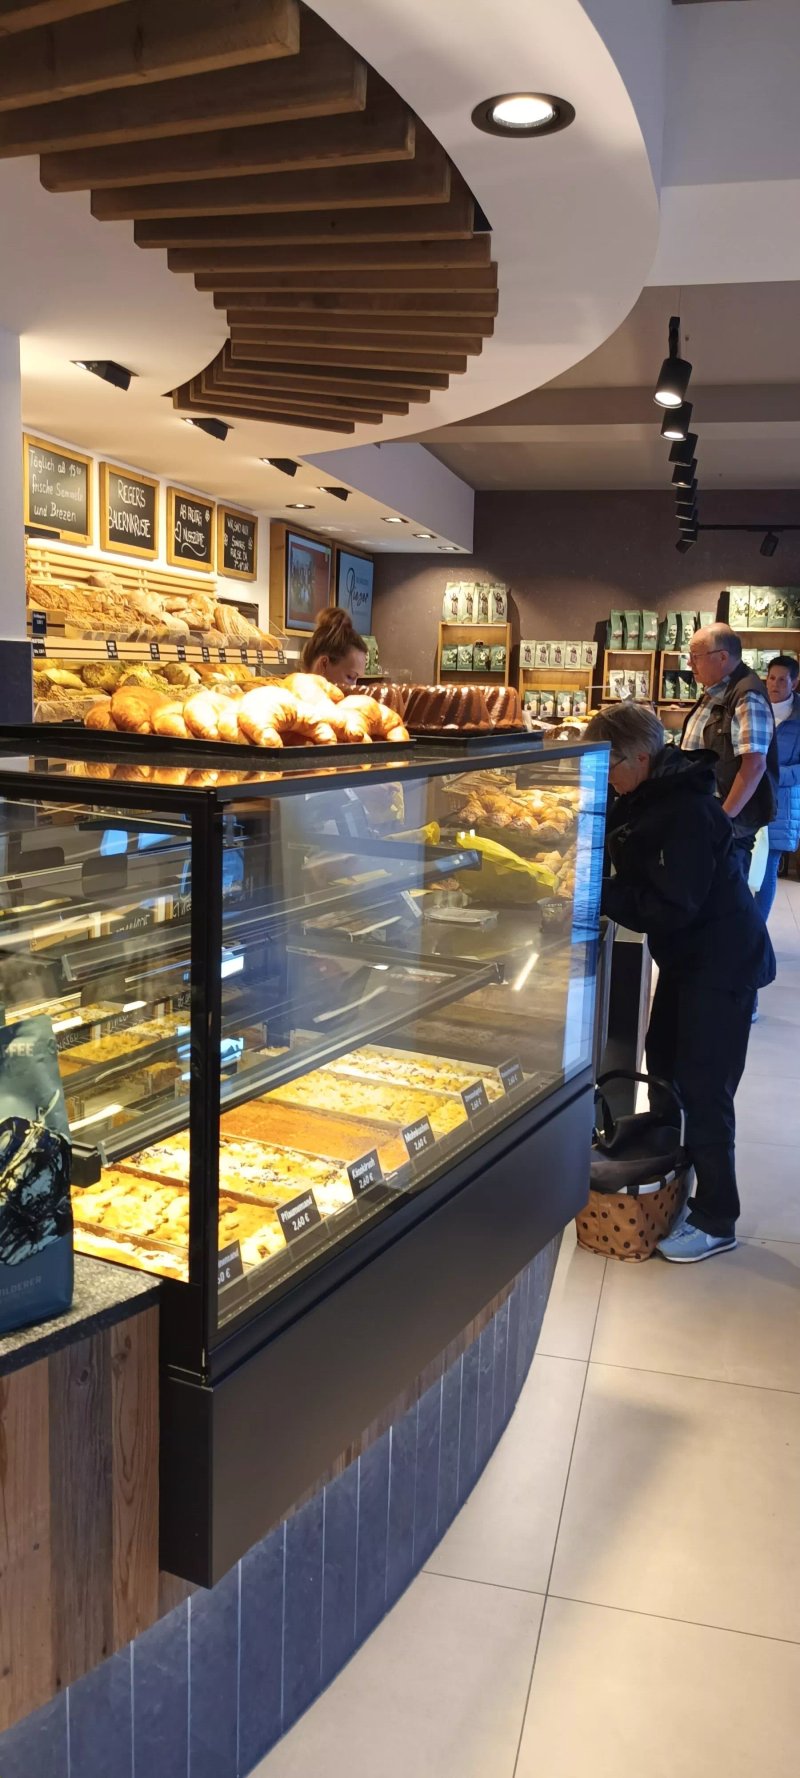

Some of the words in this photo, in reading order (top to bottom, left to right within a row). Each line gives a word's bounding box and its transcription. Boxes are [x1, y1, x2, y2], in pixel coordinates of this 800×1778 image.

[30, 449, 55, 474] Täglich
[32, 474, 54, 495] frische
[33, 504, 48, 517] und
[50, 501, 77, 523] Brezen
[180, 504, 187, 520] AB
[359, 1174, 370, 1189] 2,60
[291, 1215, 304, 1231] 2,60
[304, 1212, 310, 1222] €
[225, 1267, 231, 1279] €
